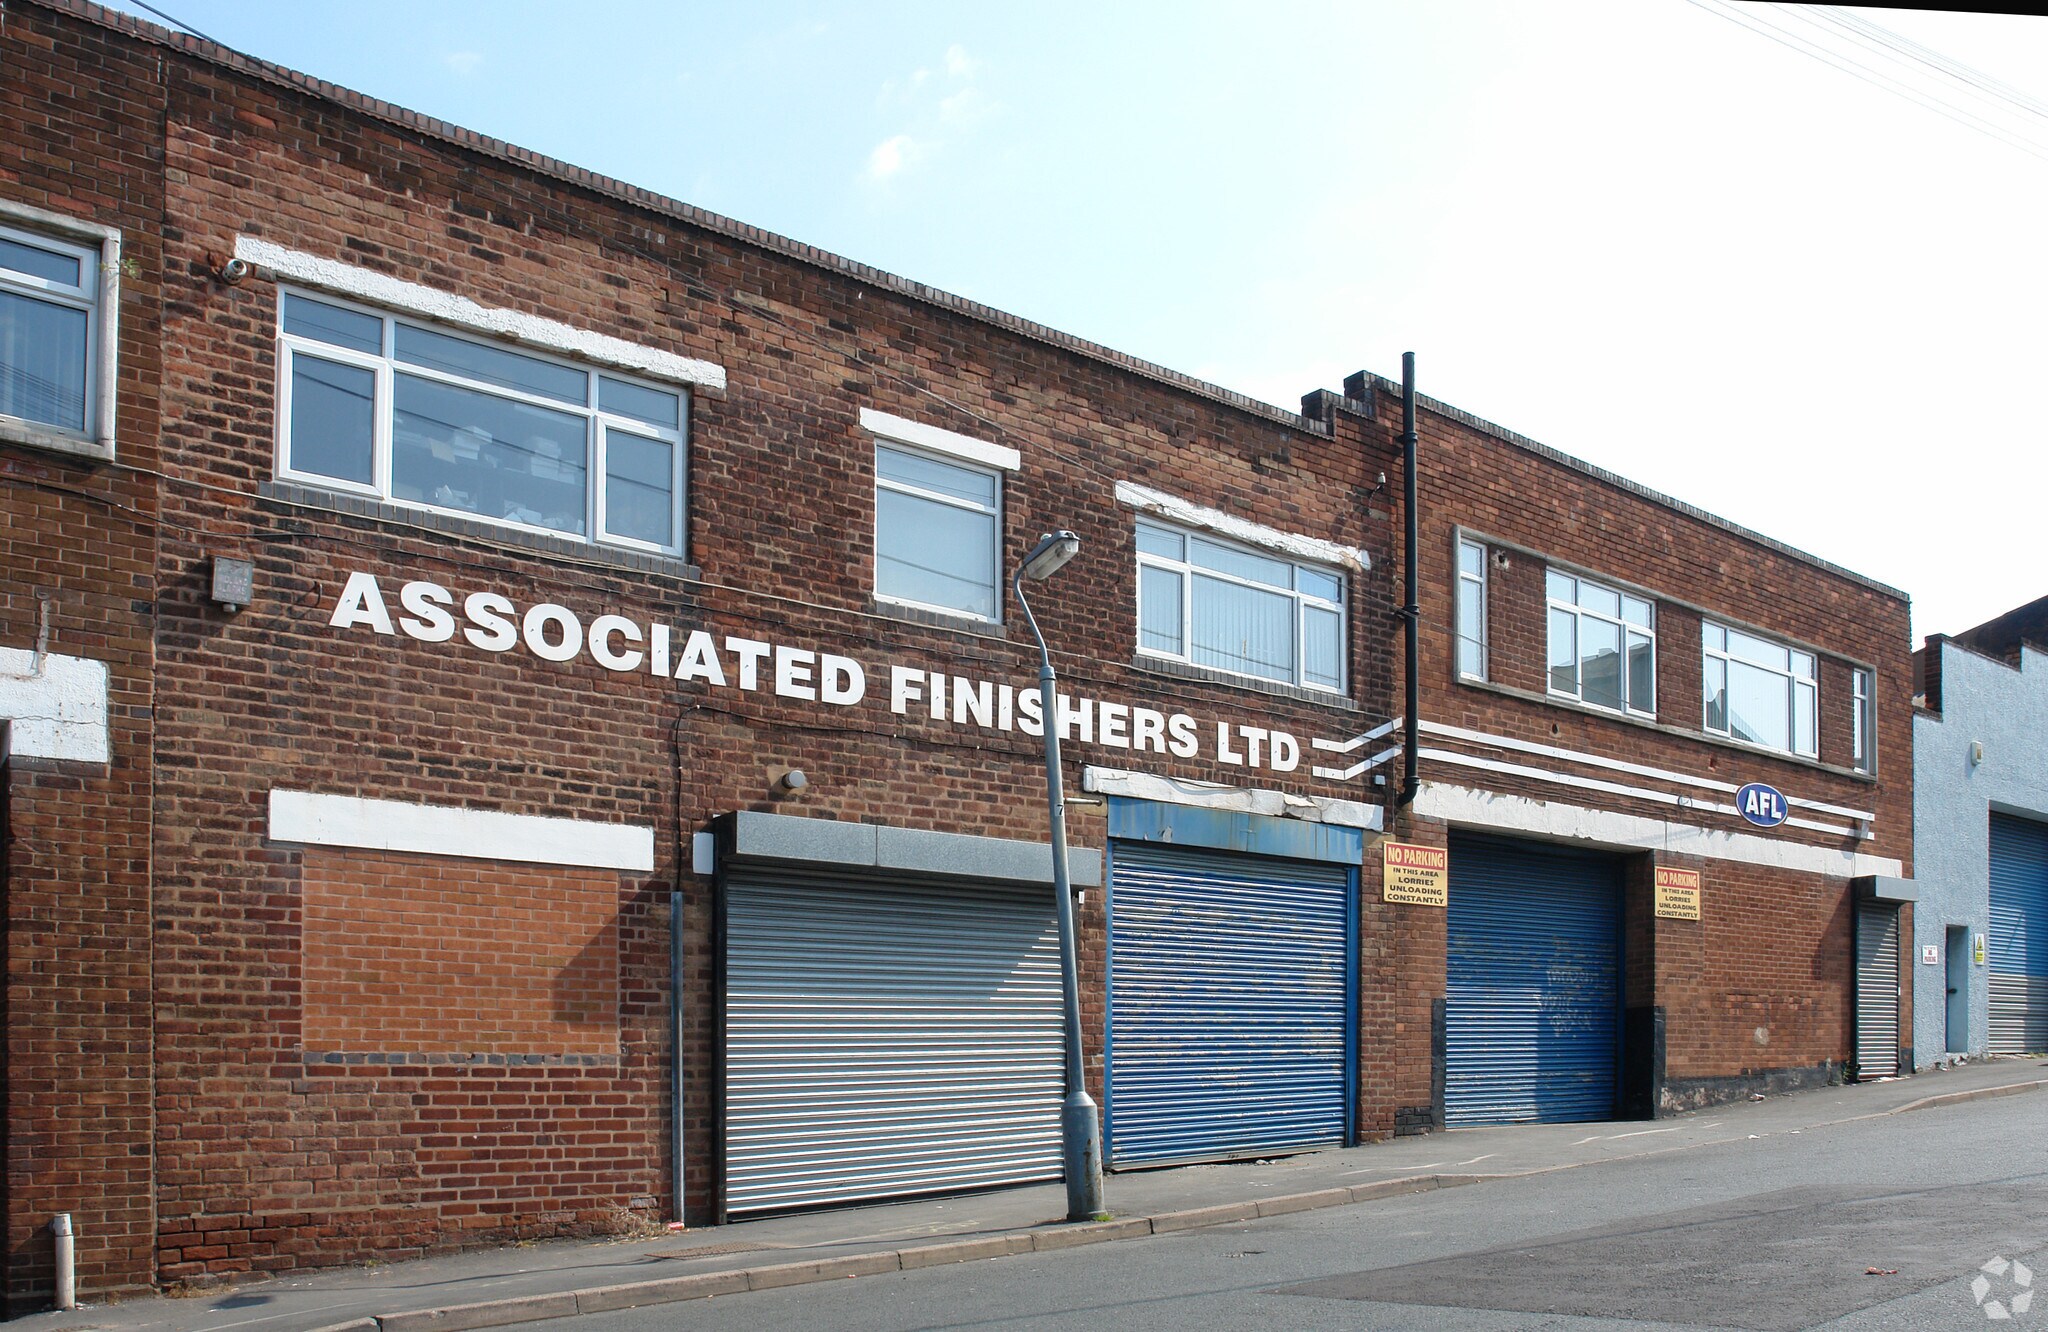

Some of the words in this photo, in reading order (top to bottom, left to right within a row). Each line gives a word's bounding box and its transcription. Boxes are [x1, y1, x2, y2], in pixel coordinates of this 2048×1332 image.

[329, 571, 866, 706] ASSOCIATED
[891, 665, 1199, 758] FINISHERS
[1217, 721, 1300, 772] LTD
[1745, 789, 1782, 819] AFL
[1057, 804, 1064, 816] 7
[1388, 847, 1402, 863] NO
[1404, 849, 1443, 867] PARKING
[1398, 877, 1434, 885] LORRIES
[1658, 870, 1668, 884] NO
[1669, 872, 1696, 887] PARKING
[1390, 885, 1442, 895] UNLOADING
[1387, 893, 1444, 904] CONSTANTLY
[1665, 895, 1691, 903] LORRIES
[1659, 902, 1696, 910] UNLOADING
[1657, 910, 1697, 918] CONSTANTLY
